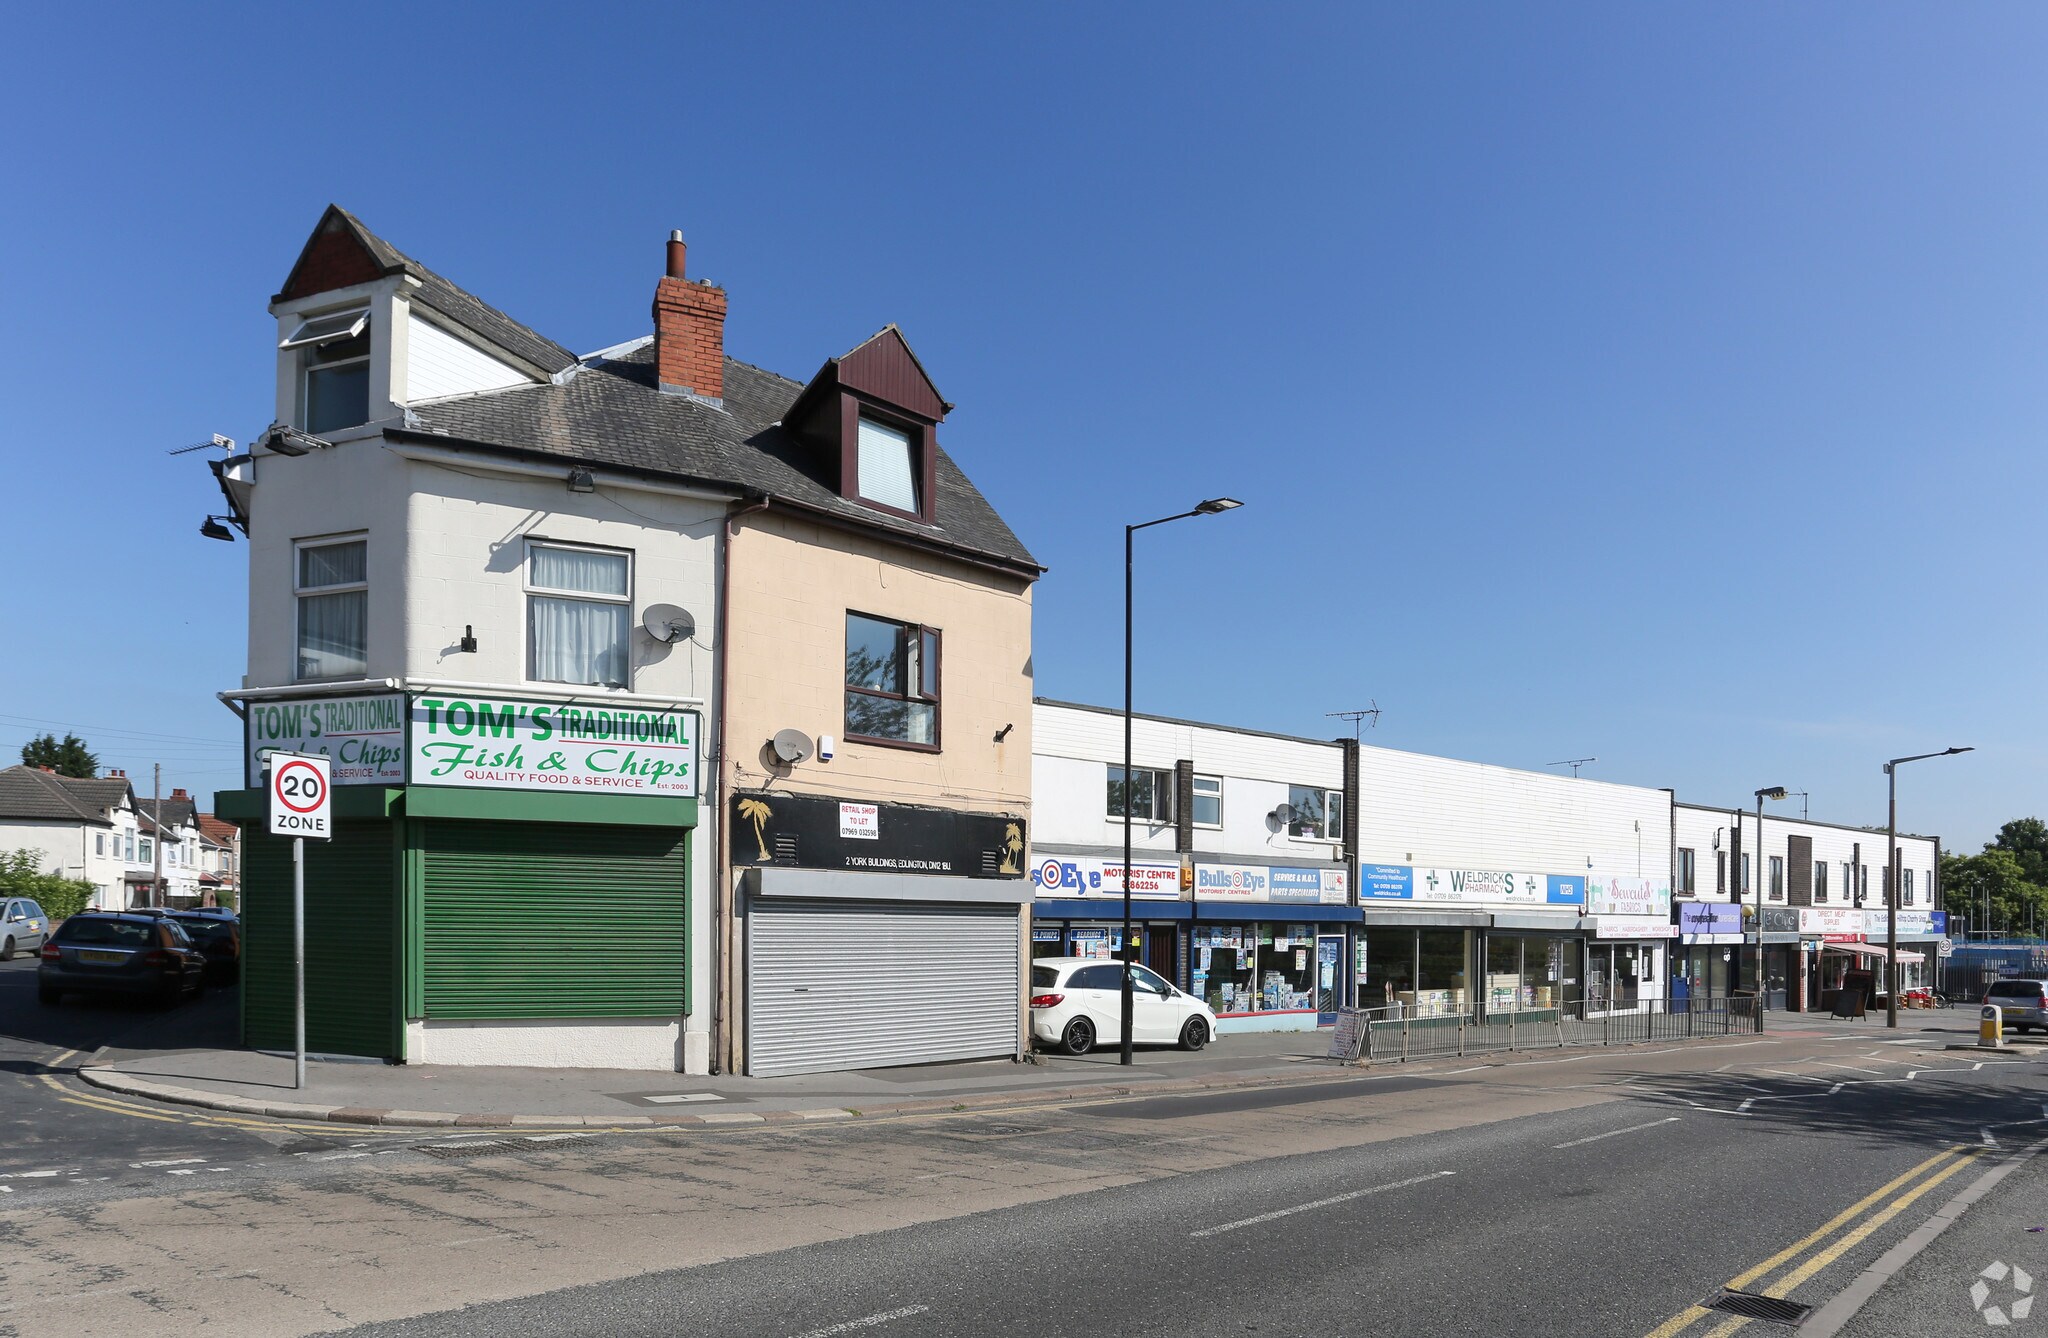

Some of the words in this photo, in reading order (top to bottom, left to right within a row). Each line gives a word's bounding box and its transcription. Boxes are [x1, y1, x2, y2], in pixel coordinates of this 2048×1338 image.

[254, 703, 321, 740] TOM'S
[324, 699, 401, 732] TRADITIONAL
[421, 699, 553, 741] TOM'S
[558, 708, 690, 745] TRADITIONAL
[339, 738, 401, 773] Chips
[421, 741, 524, 776] Fish
[537, 751, 568, 771] &
[585, 749, 689, 785] Chips
[339, 768, 373, 778] SERVICE
[464, 769, 526, 782] QUALITY
[529, 773, 569, 784] FOOD
[572, 776, 582, 785] &
[584, 776, 644, 789] SERVICE
[283, 775, 319, 798] 20
[841, 806, 860, 815] RETAIL
[278, 815, 325, 831] ZONE
[850, 817, 858, 825] TO
[841, 827, 858, 836] 07969
[845, 856, 850, 866] 2
[851, 857, 867, 866] YORK
[1062, 863, 1101, 895] Eye
[1146, 870, 1176, 880] CENTRE
[1274, 873, 1296, 882] SERVICE
[1296, 874, 1301, 882] &
[1199, 869, 1232, 887] Bulls
[1243, 871, 1265, 892] Eye
[1450, 870, 1515, 894] WELDRICKS
[1270, 887, 1288, 897] PARTS
[1288, 888, 1319, 897] SPECIALISTS
[1465, 883, 1504, 894] PHARMACY
[1561, 885, 1572, 894] NHS
[1620, 902, 1641, 912] FABRICS
[1773, 912, 1794, 926] Chic
[1818, 910, 1833, 918] DIRECT
[1076, 931, 1102, 939] BEARINGS
